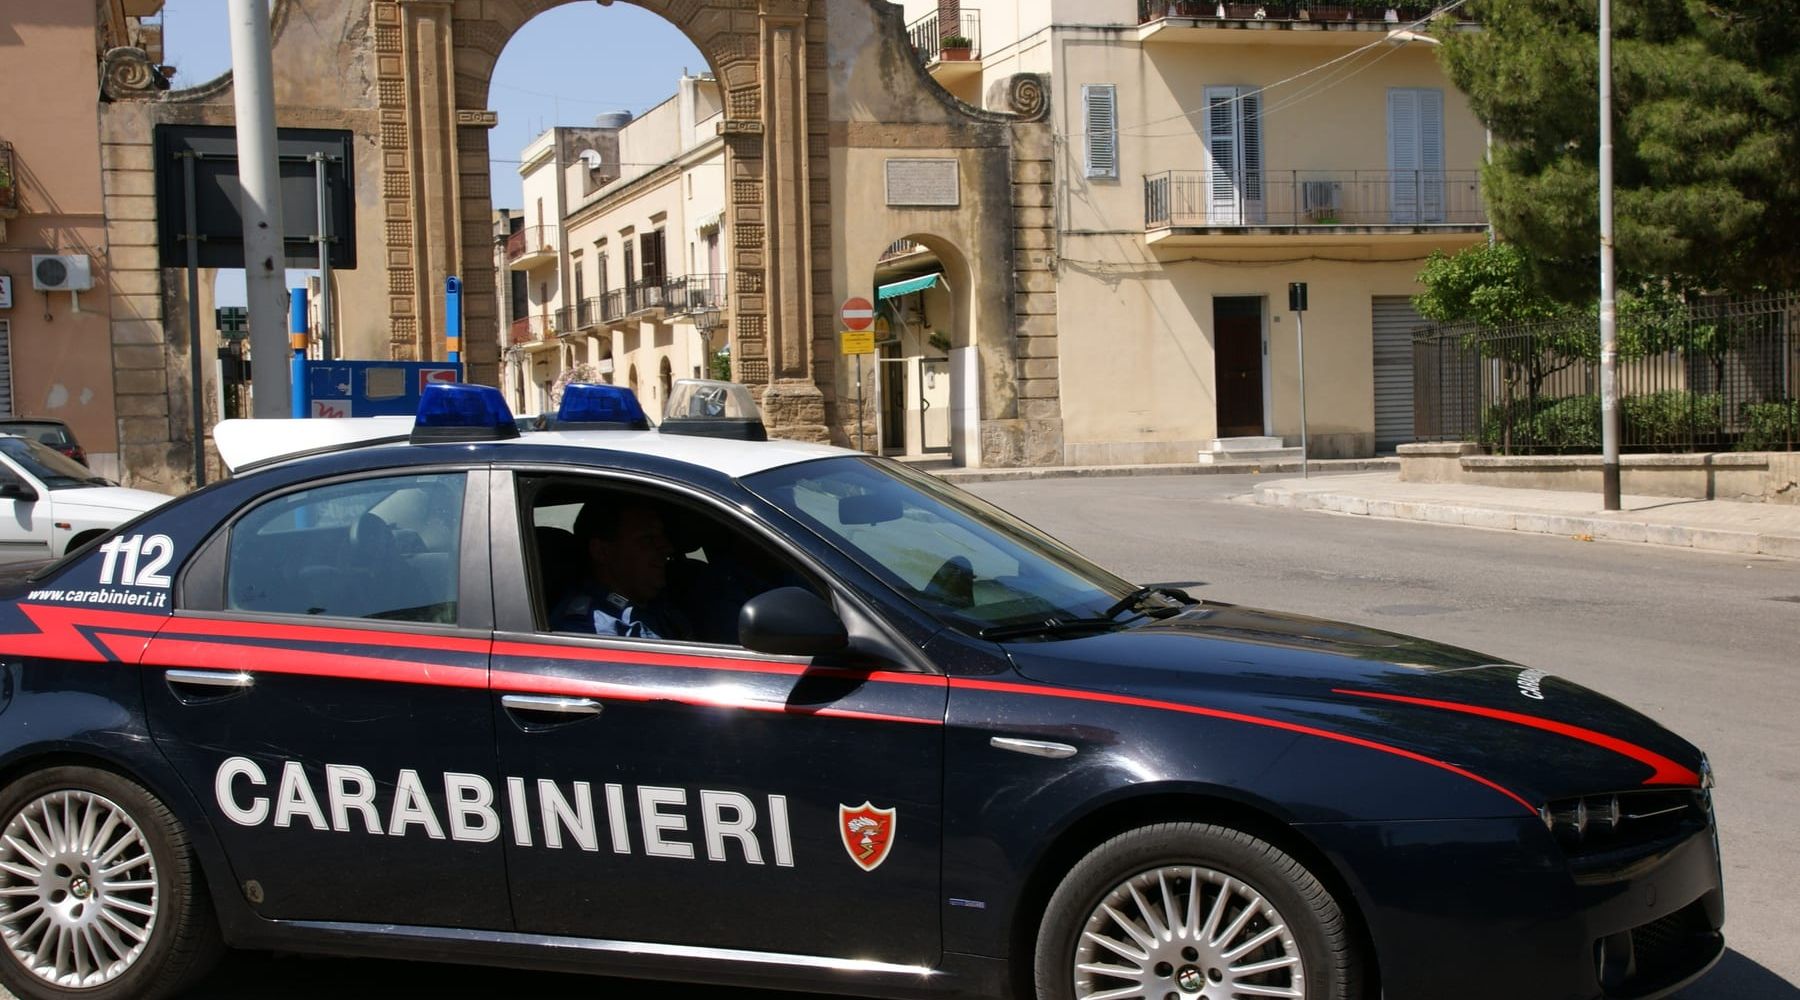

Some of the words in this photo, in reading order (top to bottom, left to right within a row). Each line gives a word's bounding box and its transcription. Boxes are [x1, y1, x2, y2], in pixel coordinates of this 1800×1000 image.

[99, 534, 175, 588] 112
[27, 587, 168, 608] www.carabinieri.it
[215, 756, 795, 868] CARABINIERI
